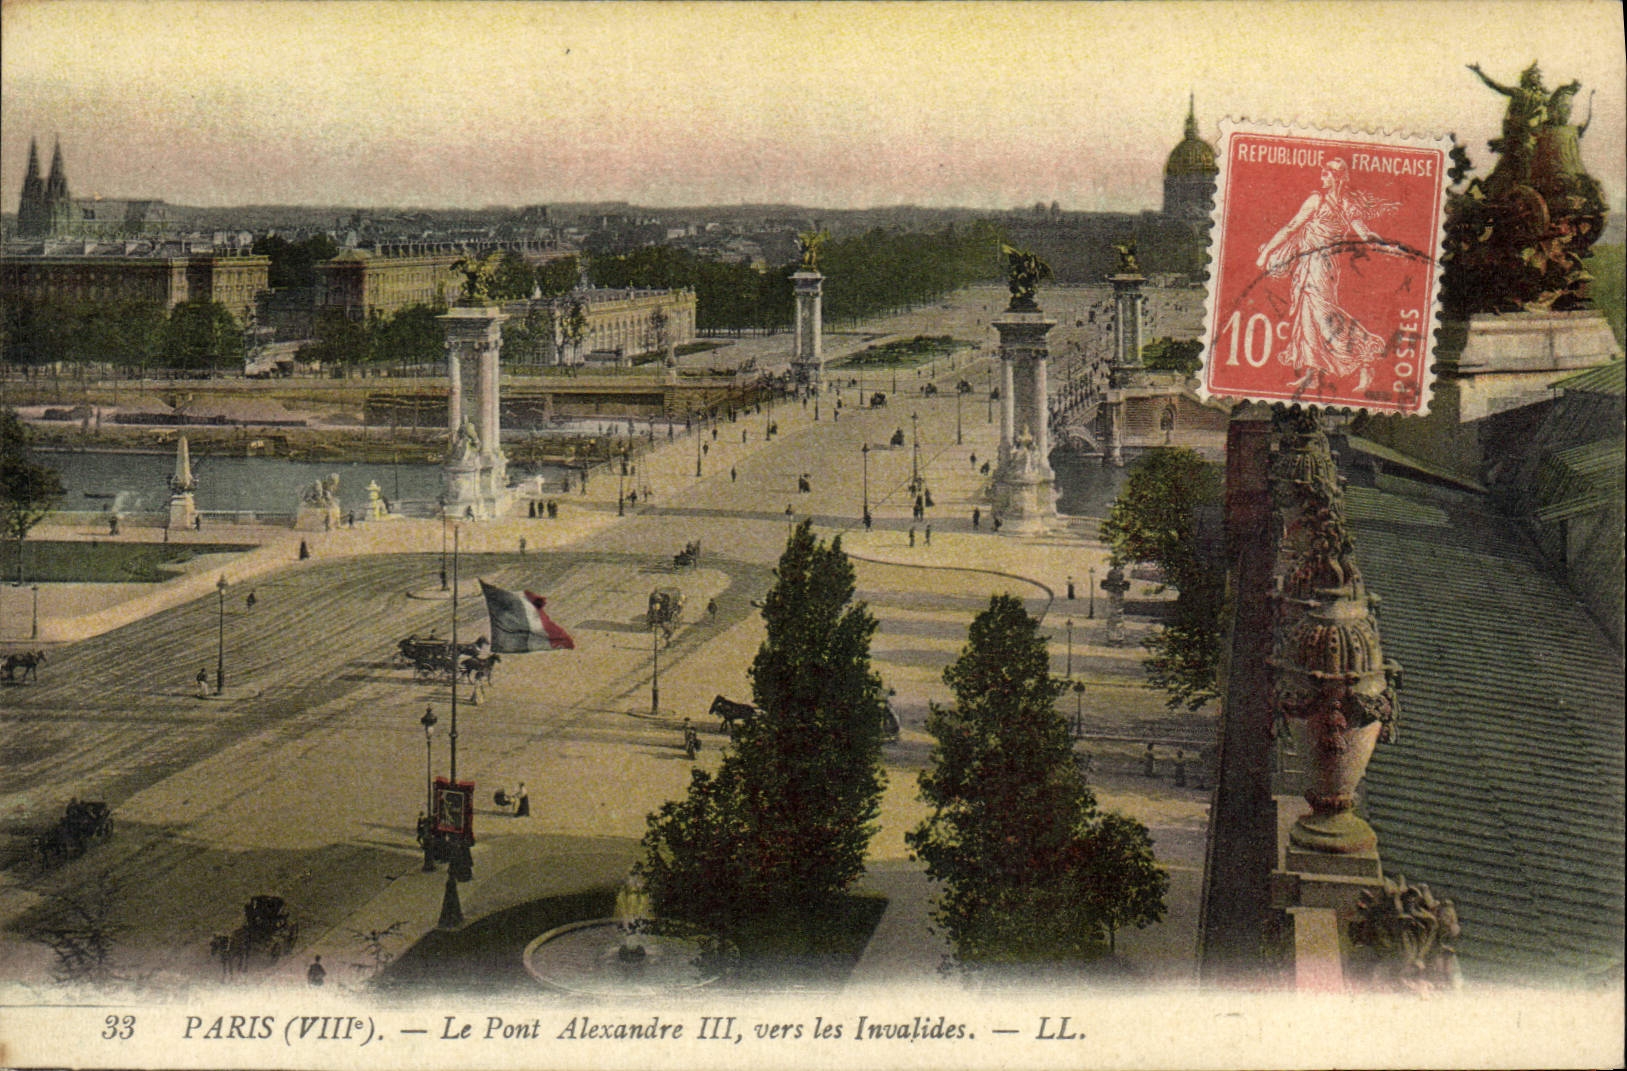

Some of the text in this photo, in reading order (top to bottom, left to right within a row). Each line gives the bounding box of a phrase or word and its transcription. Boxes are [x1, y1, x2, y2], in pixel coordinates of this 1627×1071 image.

[1238, 143, 1433, 177] REPUBLIQUE FRANÇAISE
[1393, 308, 1420, 394] POSTES
